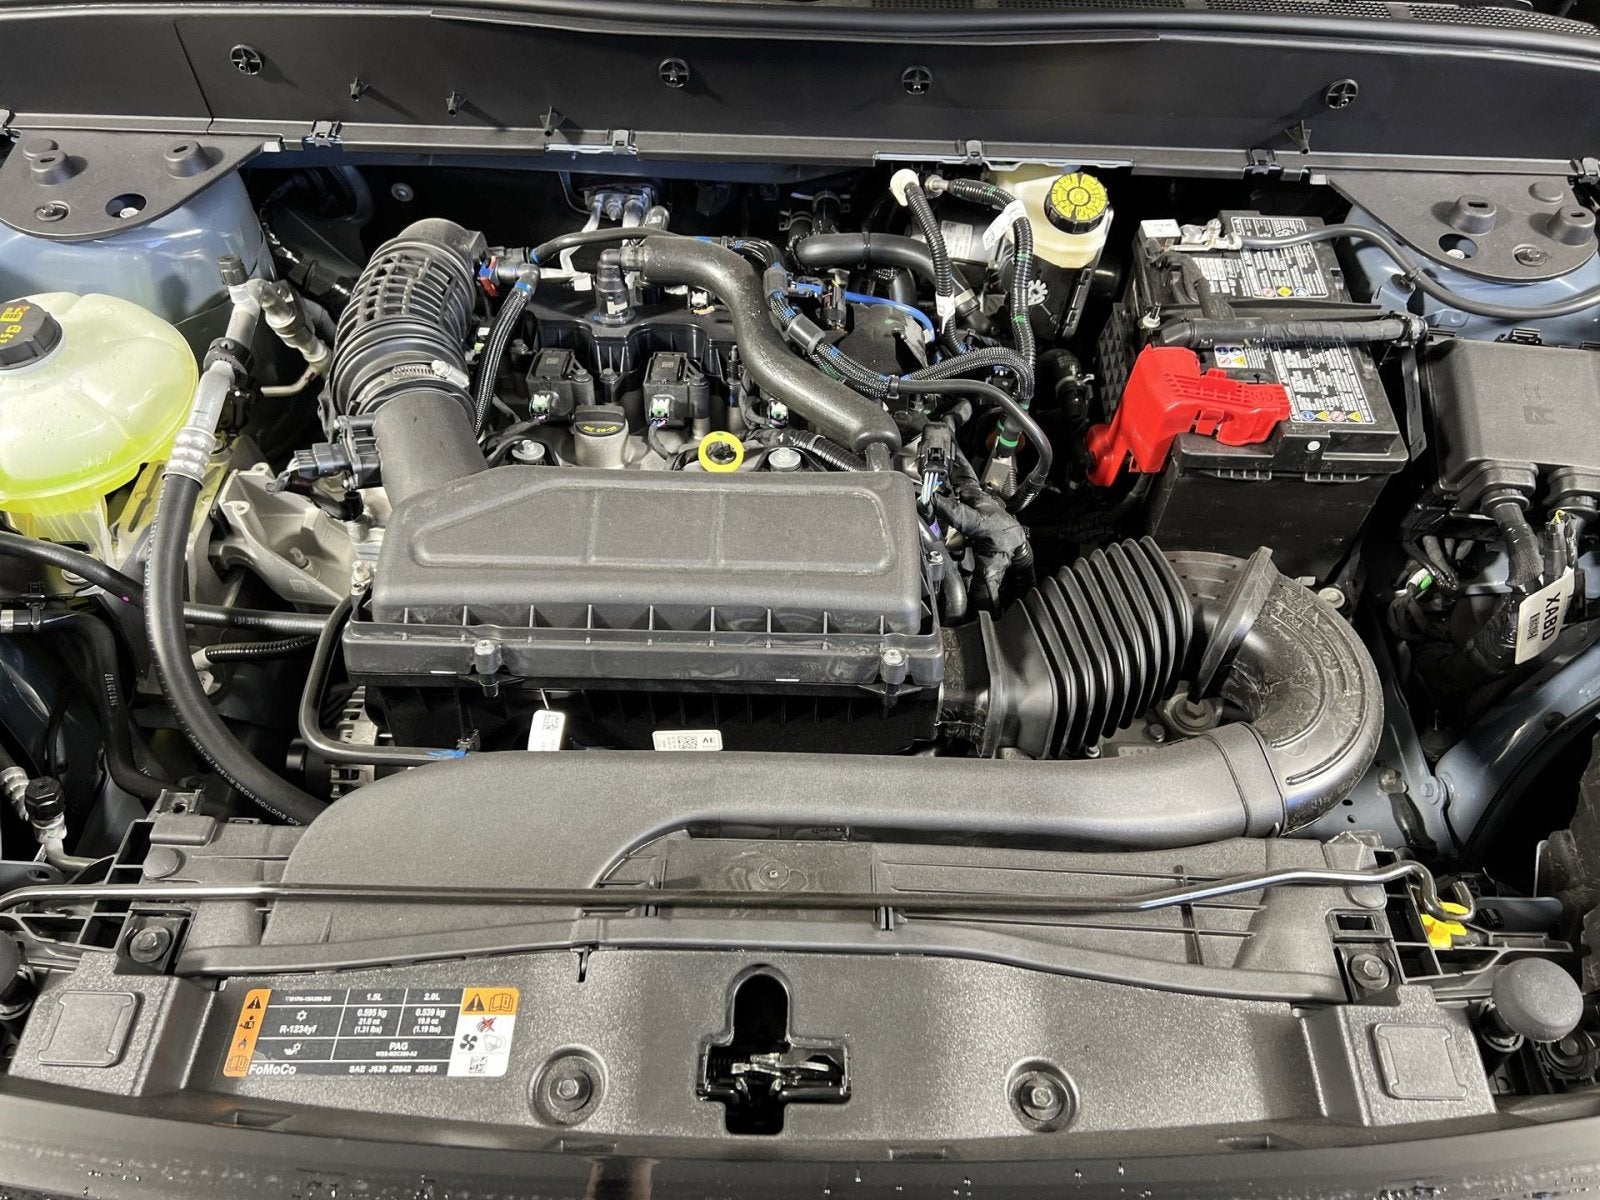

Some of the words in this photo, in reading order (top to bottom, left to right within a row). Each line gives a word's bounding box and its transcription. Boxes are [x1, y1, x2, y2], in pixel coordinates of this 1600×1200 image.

[1541, 591, 1561, 641] XABD
[235, 782, 255, 800] HOSE
[255, 797, 287, 820] SUCTION
[366, 993, 382, 1001] 1.5L
[423, 993, 441, 1001] 2.0L
[378, 1008, 388, 1019] kg
[415, 1008, 435, 1017] 0.539
[435, 1008, 446, 1019] kg
[279, 1024, 318, 1035] R-1234yf
[354, 1025, 370, 1035] (1.31
[370, 1025, 382, 1035] lbs)
[412, 1025, 428, 1035] (1.19
[428, 1025, 441, 1035] lbs)
[389, 1042, 409, 1051] PAG
[248, 1063, 297, 1075] FoMoCo
[349, 1065, 366, 1073] SAE
[368, 1065, 387, 1073] J639
[389, 1065, 412, 1073] J2842
[415, 1065, 438, 1073] J2845
